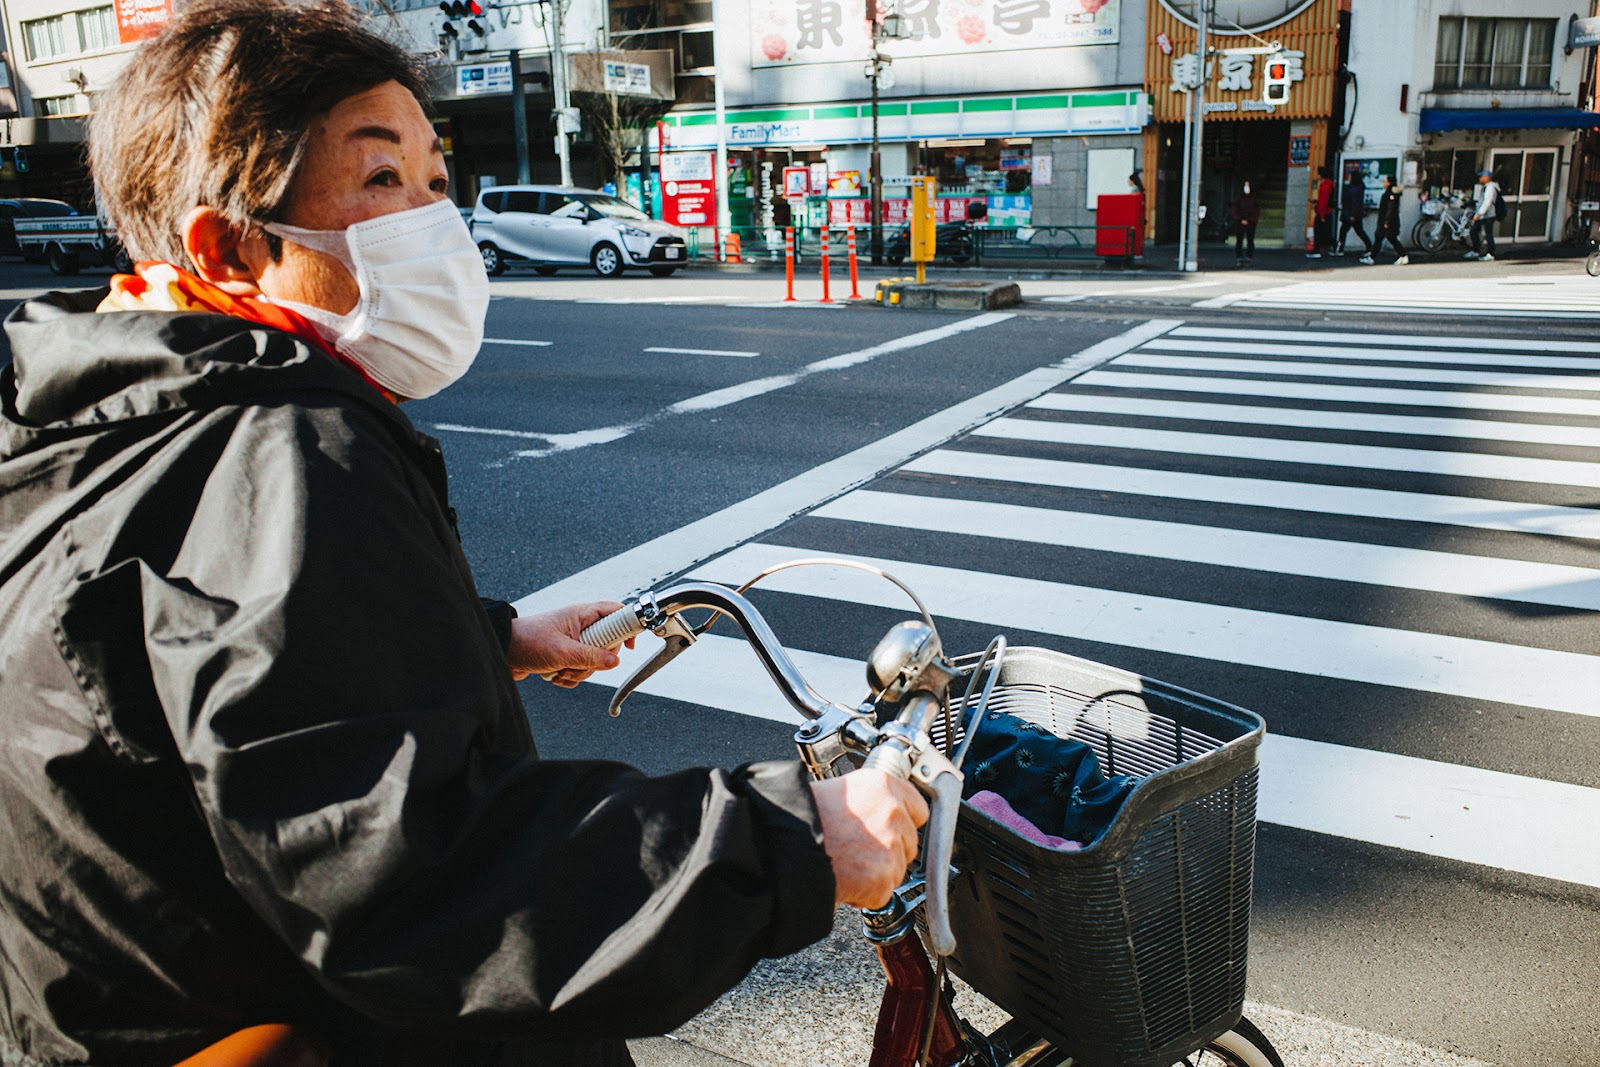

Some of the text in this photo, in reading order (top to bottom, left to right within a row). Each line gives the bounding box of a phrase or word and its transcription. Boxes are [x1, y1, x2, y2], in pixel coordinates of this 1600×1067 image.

[136, 8, 167, 25] Donut
[731, 124, 800, 143] FamilyMart
[759, 161, 775, 229] FamilyMa
[949, 200, 965, 210] TAX
